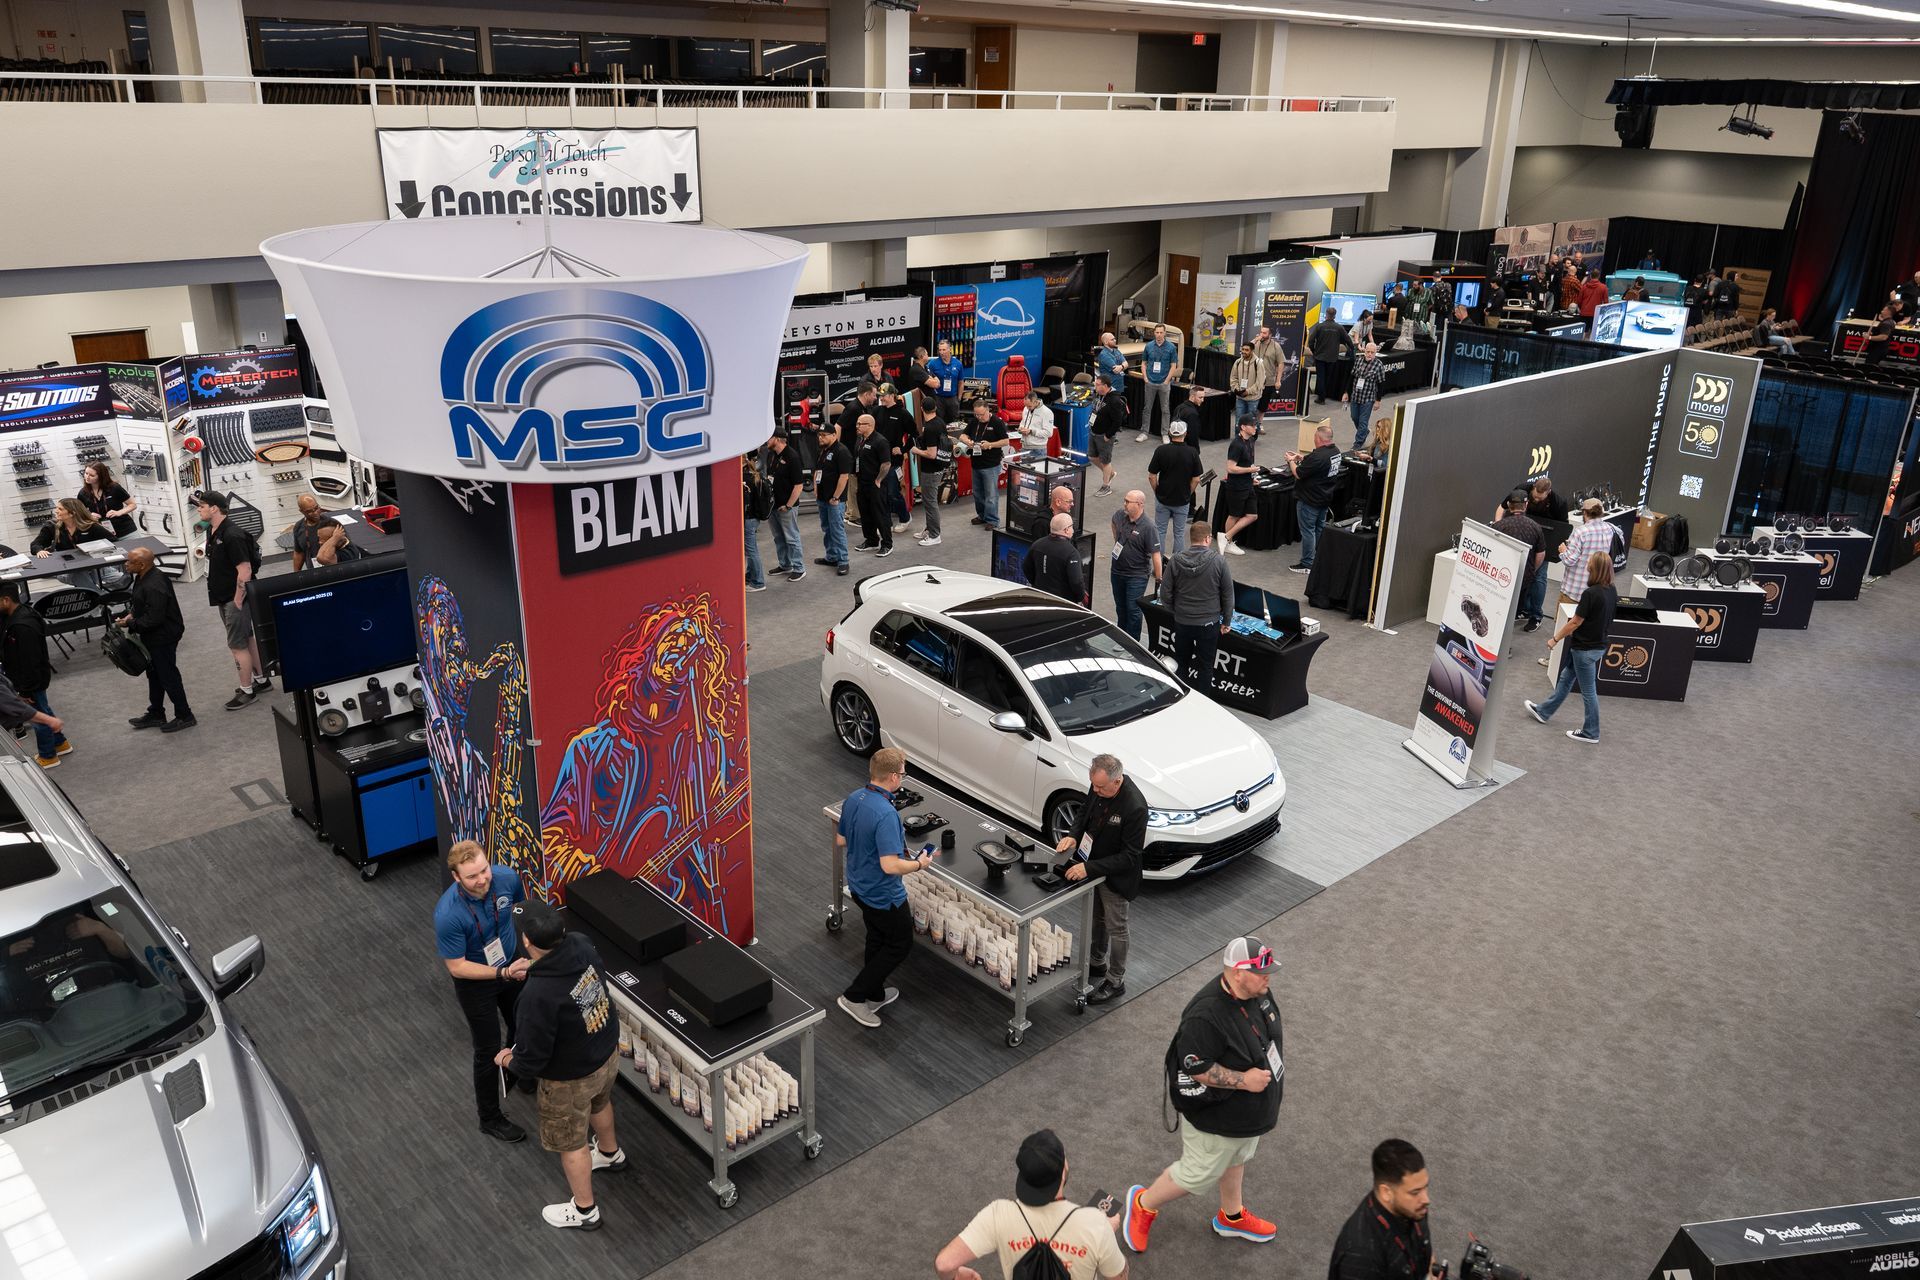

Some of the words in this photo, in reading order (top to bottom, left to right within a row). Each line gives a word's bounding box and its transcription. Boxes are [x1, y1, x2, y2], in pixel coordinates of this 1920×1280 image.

[561, 139, 608, 161] Touch
[518, 165, 588, 177] Caering
[431, 181, 667, 217] Concessions
[1267, 294, 1305, 302] CAMaster
[866, 316, 906, 329] BROS
[870, 335, 906, 346] ALCANTARA
[780, 349, 817, 358] CARPET
[202, 368, 298, 386] MASTERTECH
[215, 379, 266, 389] CERTIFIED
[1648, 420, 1660, 453] THE
[1655, 363, 1671, 417] MUSIC
[1690, 400, 1726, 415] morel
[448, 395, 710, 465] MSC
[1684, 421, 1719, 445] 50
[571, 467, 700, 554] BLAM
[1462, 537, 1492, 559] ESCORT
[1461, 550, 1491, 574] REDLINE
[1605, 643, 1649, 669] 50
[1427, 685, 1435, 695] THE
[1434, 689, 1453, 706] DRIVING
[1434, 702, 1475, 736] AWAKENED
[1448, 747, 1465, 765] MSC
[619, 973, 637, 987] BLAM
[1764, 1222, 1818, 1241] Rockford
[1869, 1257, 1920, 1272] AUDIO
[1874, 1251, 1914, 1262] MOBILE
